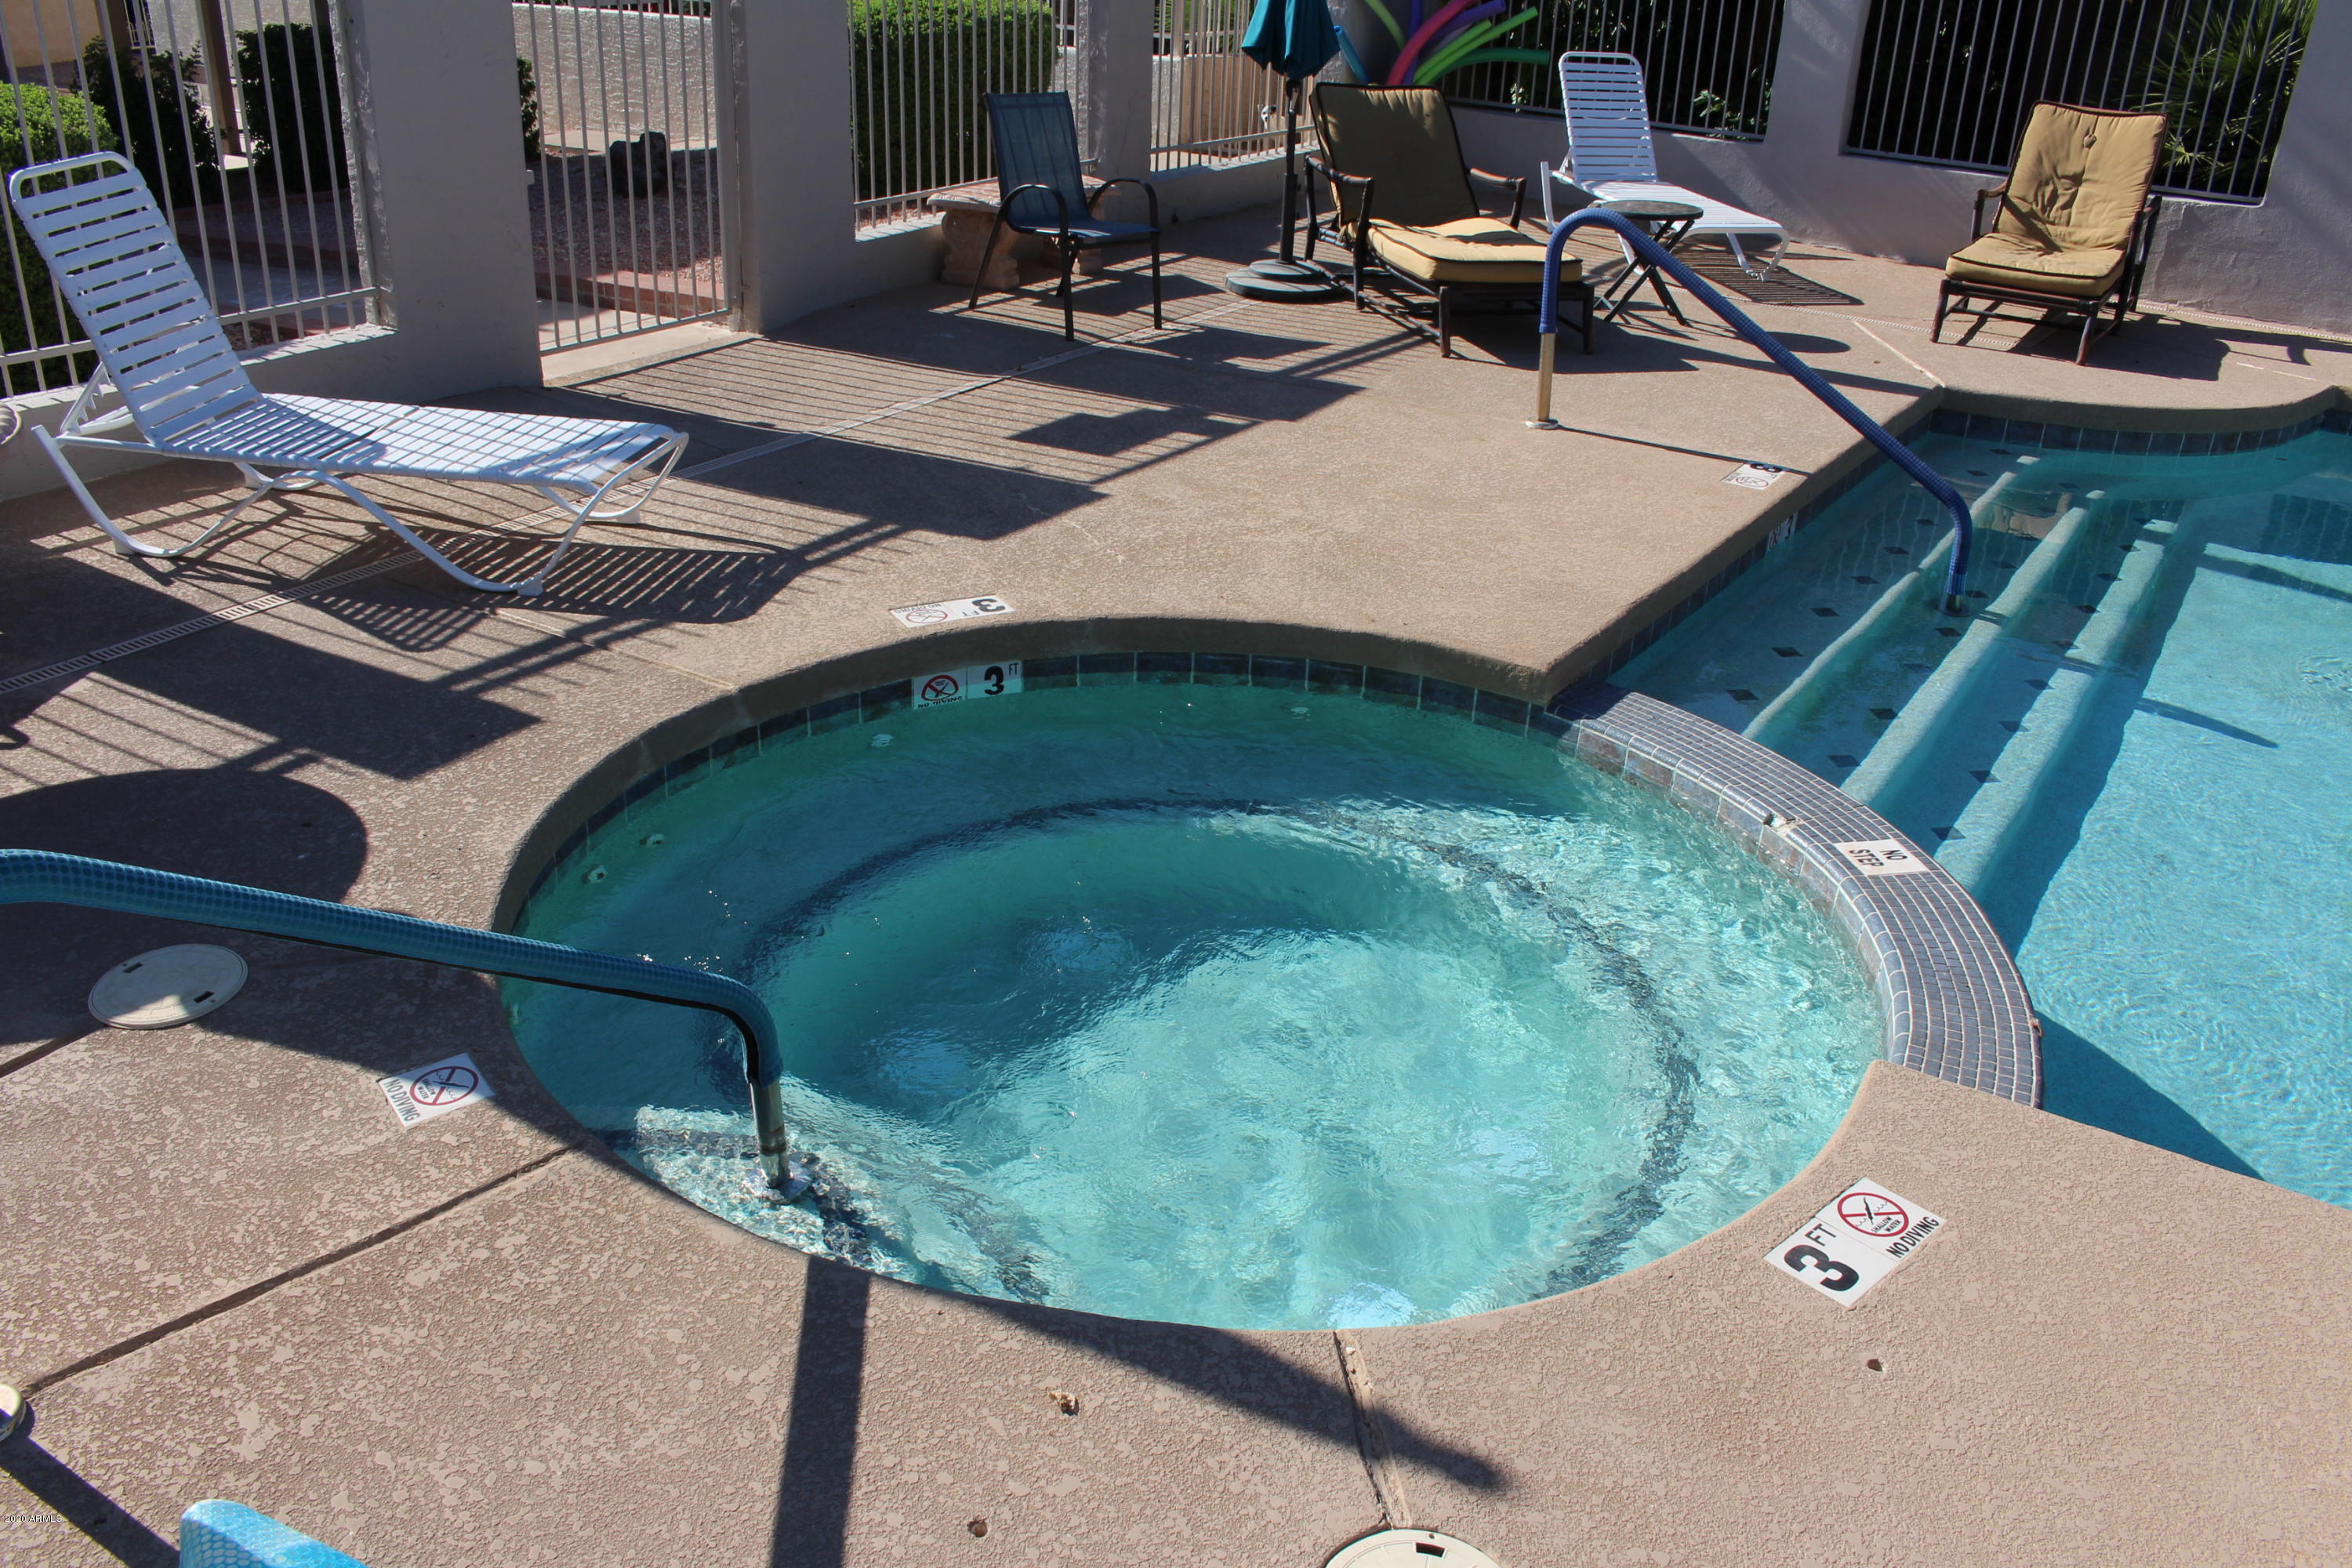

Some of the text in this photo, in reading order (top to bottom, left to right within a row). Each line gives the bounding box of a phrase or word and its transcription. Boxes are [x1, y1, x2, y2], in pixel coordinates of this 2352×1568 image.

[972, 598, 1006, 612] 3
[984, 662, 1018, 695] 3 FT
[1849, 848, 1885, 867] STEP
[1879, 849, 1908, 861] NO
[383, 1078, 421, 1122] NO DIVING
[1871, 1216, 1893, 1233] SHALLOW
[1885, 1218, 1902, 1232] WATER
[1886, 1216, 1940, 1259] NO DIVING
[1784, 1222, 1860, 1292] 3 FT
